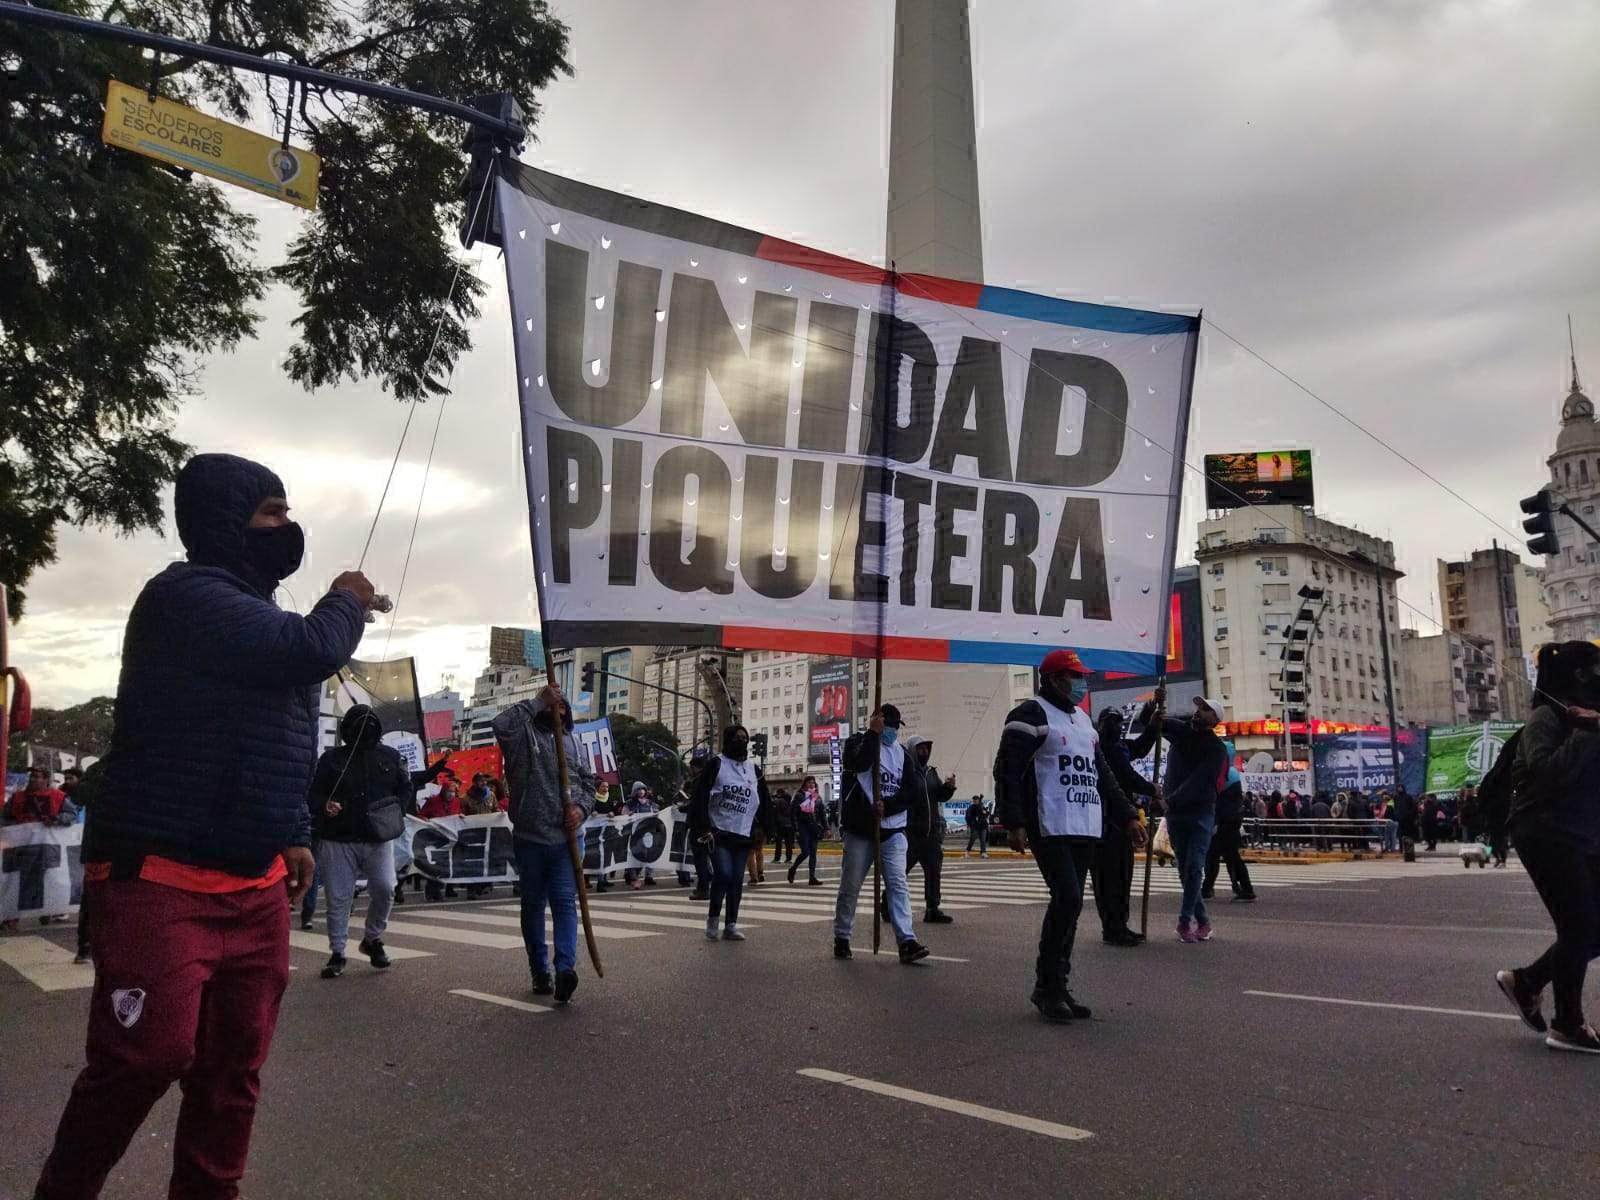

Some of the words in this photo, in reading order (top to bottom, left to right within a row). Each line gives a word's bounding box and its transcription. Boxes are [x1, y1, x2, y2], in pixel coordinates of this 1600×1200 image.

[123, 114, 222, 158] ESCOLARES
[124, 101, 224, 146] SENDEROS
[545, 237, 1130, 488] UNIDAD
[546, 424, 1113, 621] PIQUETERA
[573, 727, 618, 775] TR
[1058, 754, 1096, 774] POL
[723, 784, 751, 797] POLO
